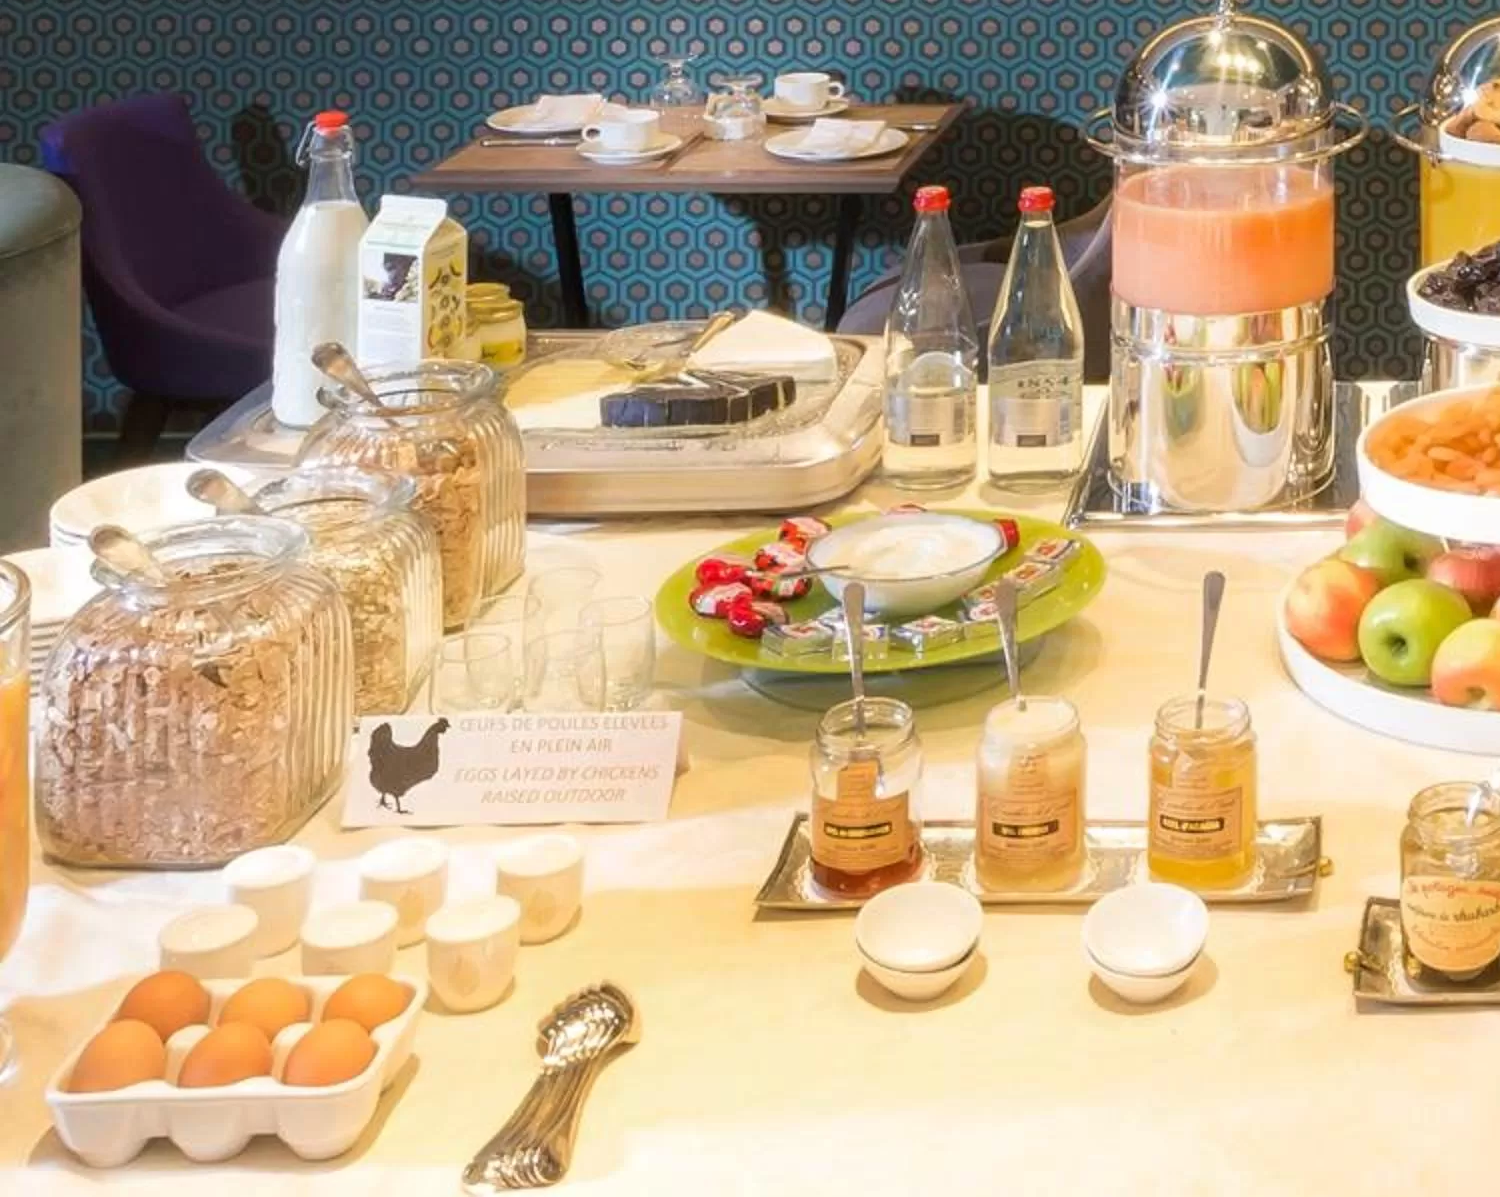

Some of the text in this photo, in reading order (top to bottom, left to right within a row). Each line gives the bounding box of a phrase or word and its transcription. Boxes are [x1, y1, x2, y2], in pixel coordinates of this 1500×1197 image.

[512, 717, 535, 731] DE
[537, 716, 600, 731] POULES
[510, 737, 613, 754] EN PLEIN AIR
[454, 764, 660, 783] EGGS LAYED BY CHICKENS
[480, 788, 627, 804] RAISED OUTDOOR
